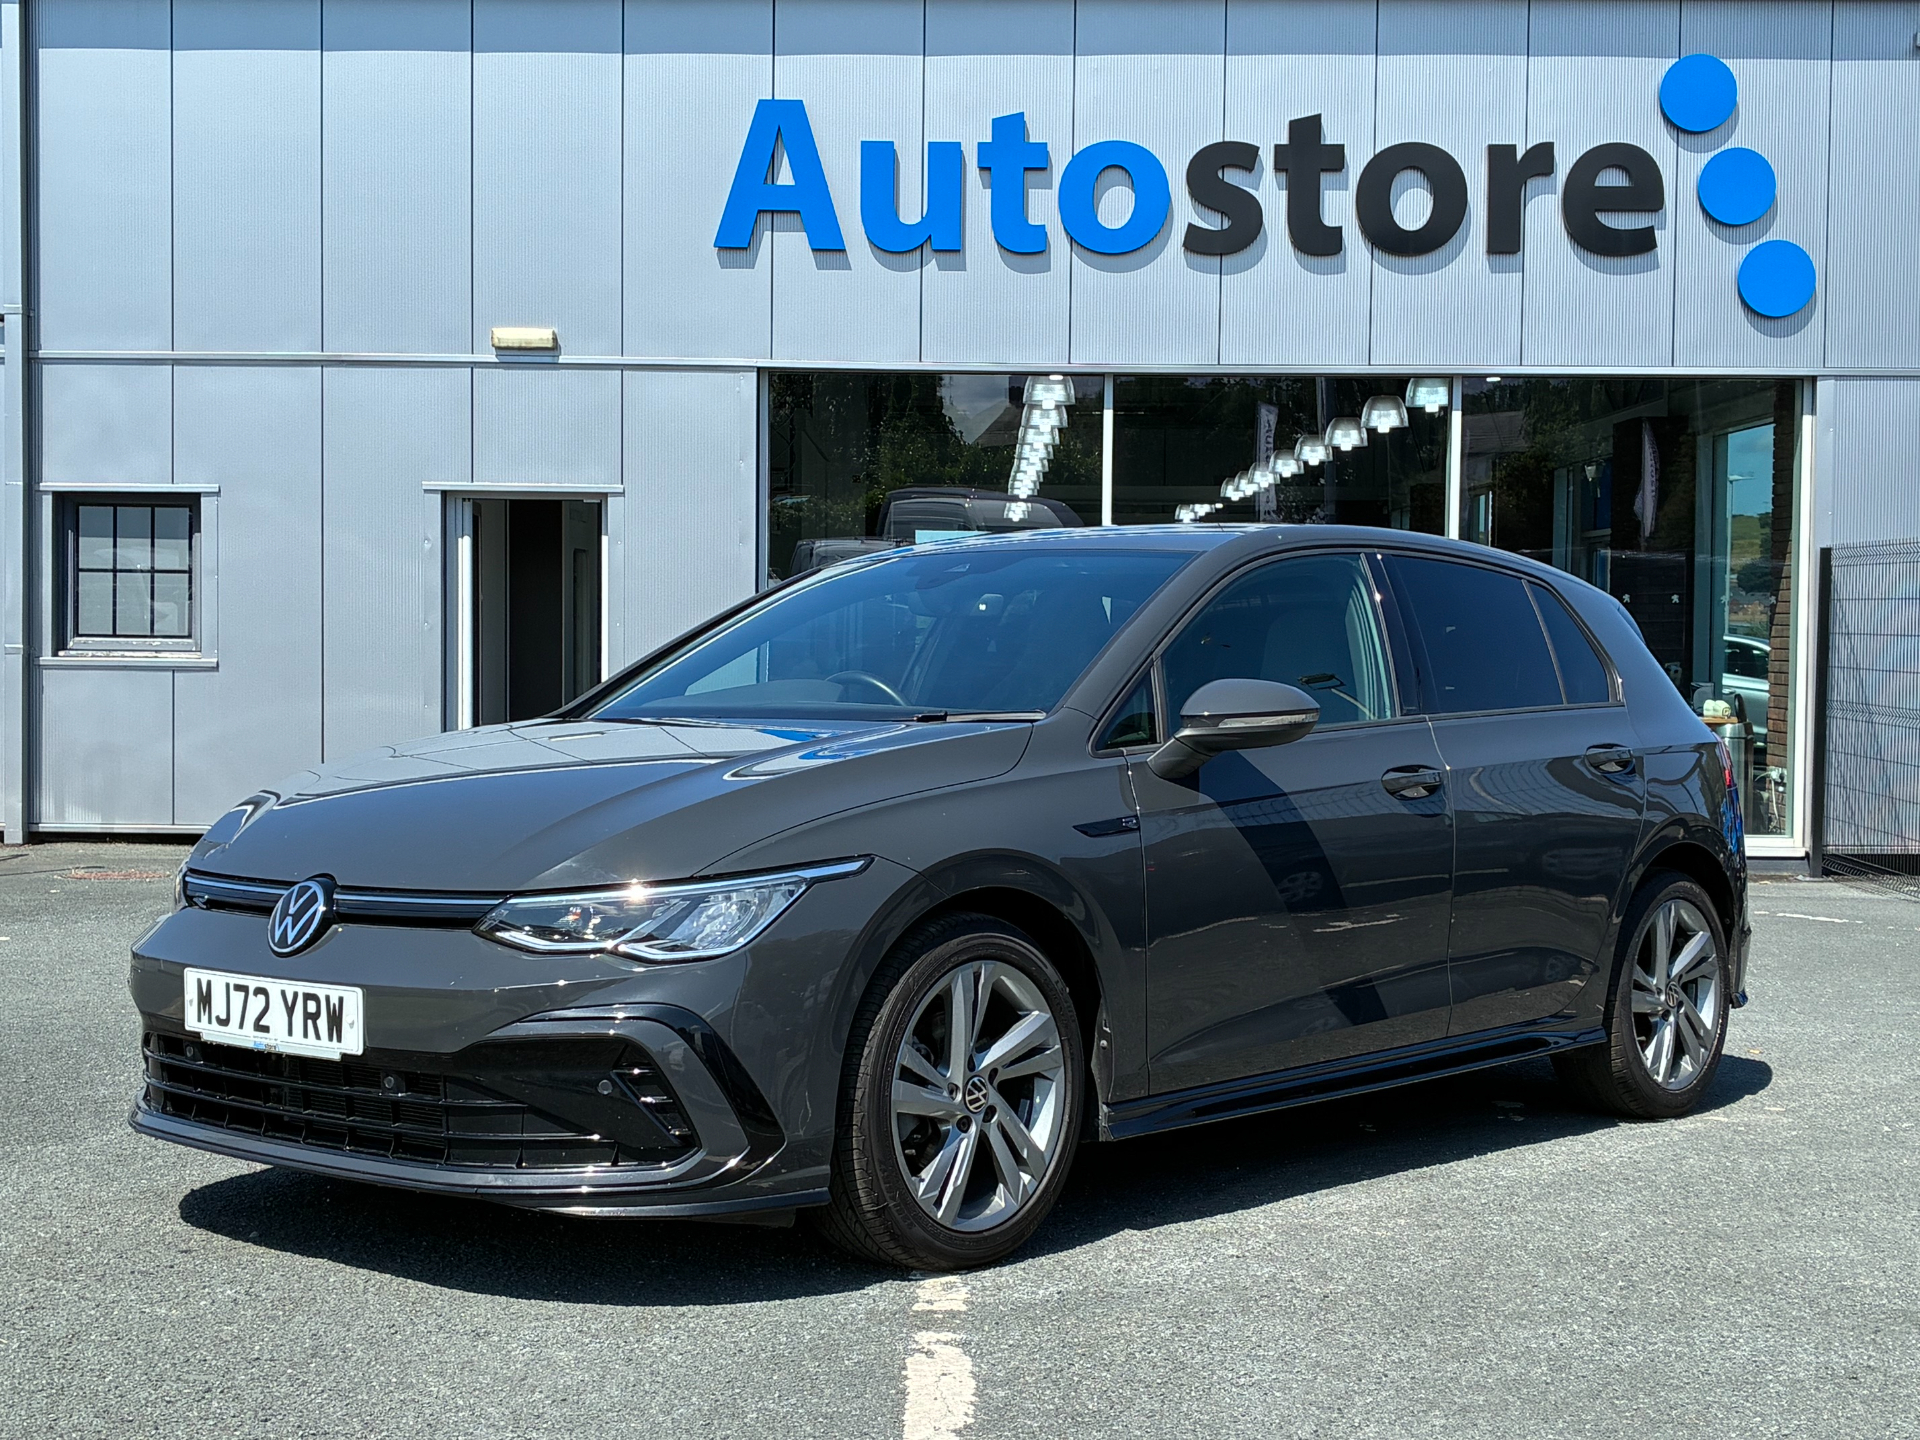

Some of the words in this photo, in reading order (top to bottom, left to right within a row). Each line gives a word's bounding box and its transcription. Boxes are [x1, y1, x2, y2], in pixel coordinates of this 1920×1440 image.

[714, 98, 1664, 257] Autostore
[197, 977, 272, 1034] MJ72
[281, 989, 344, 1044] YRW
